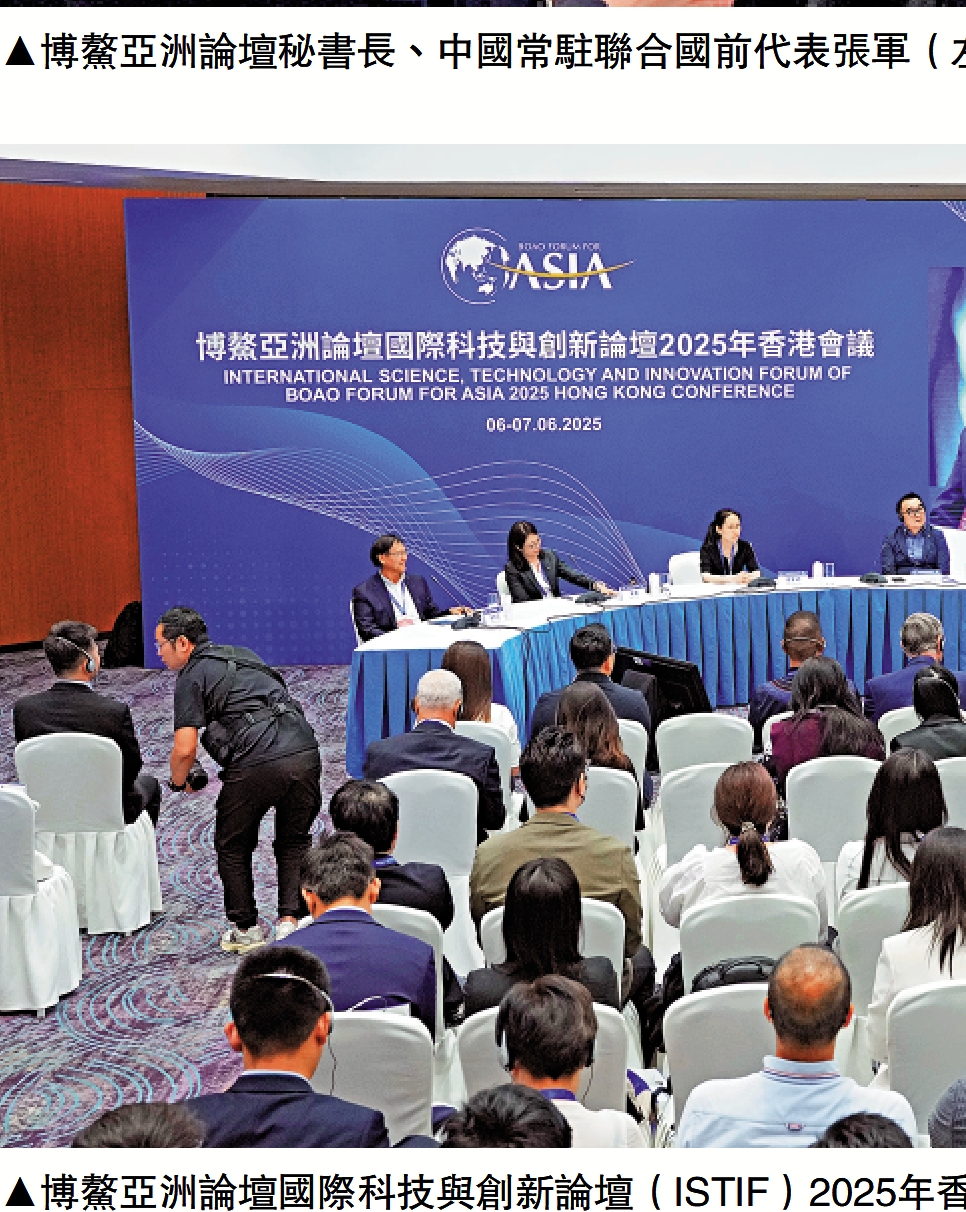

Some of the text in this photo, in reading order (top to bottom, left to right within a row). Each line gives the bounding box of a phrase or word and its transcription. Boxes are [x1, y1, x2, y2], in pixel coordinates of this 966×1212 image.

[507, 252, 613, 290] ASIA
[195, 329, 875, 361] 博鰲亞洲論壇國際科技與創新論壇2025年香港會議
[223, 366, 852, 385] INTERNATIONAL SCIENCE, TECHNOLOGY AND INNOVATION FORUM OF
[285, 384, 795, 403] BOAO FORUM FOR ASIA 2025 HONG KONG CONFERENCE
[486, 417, 602, 433] 06-07.06.2025
